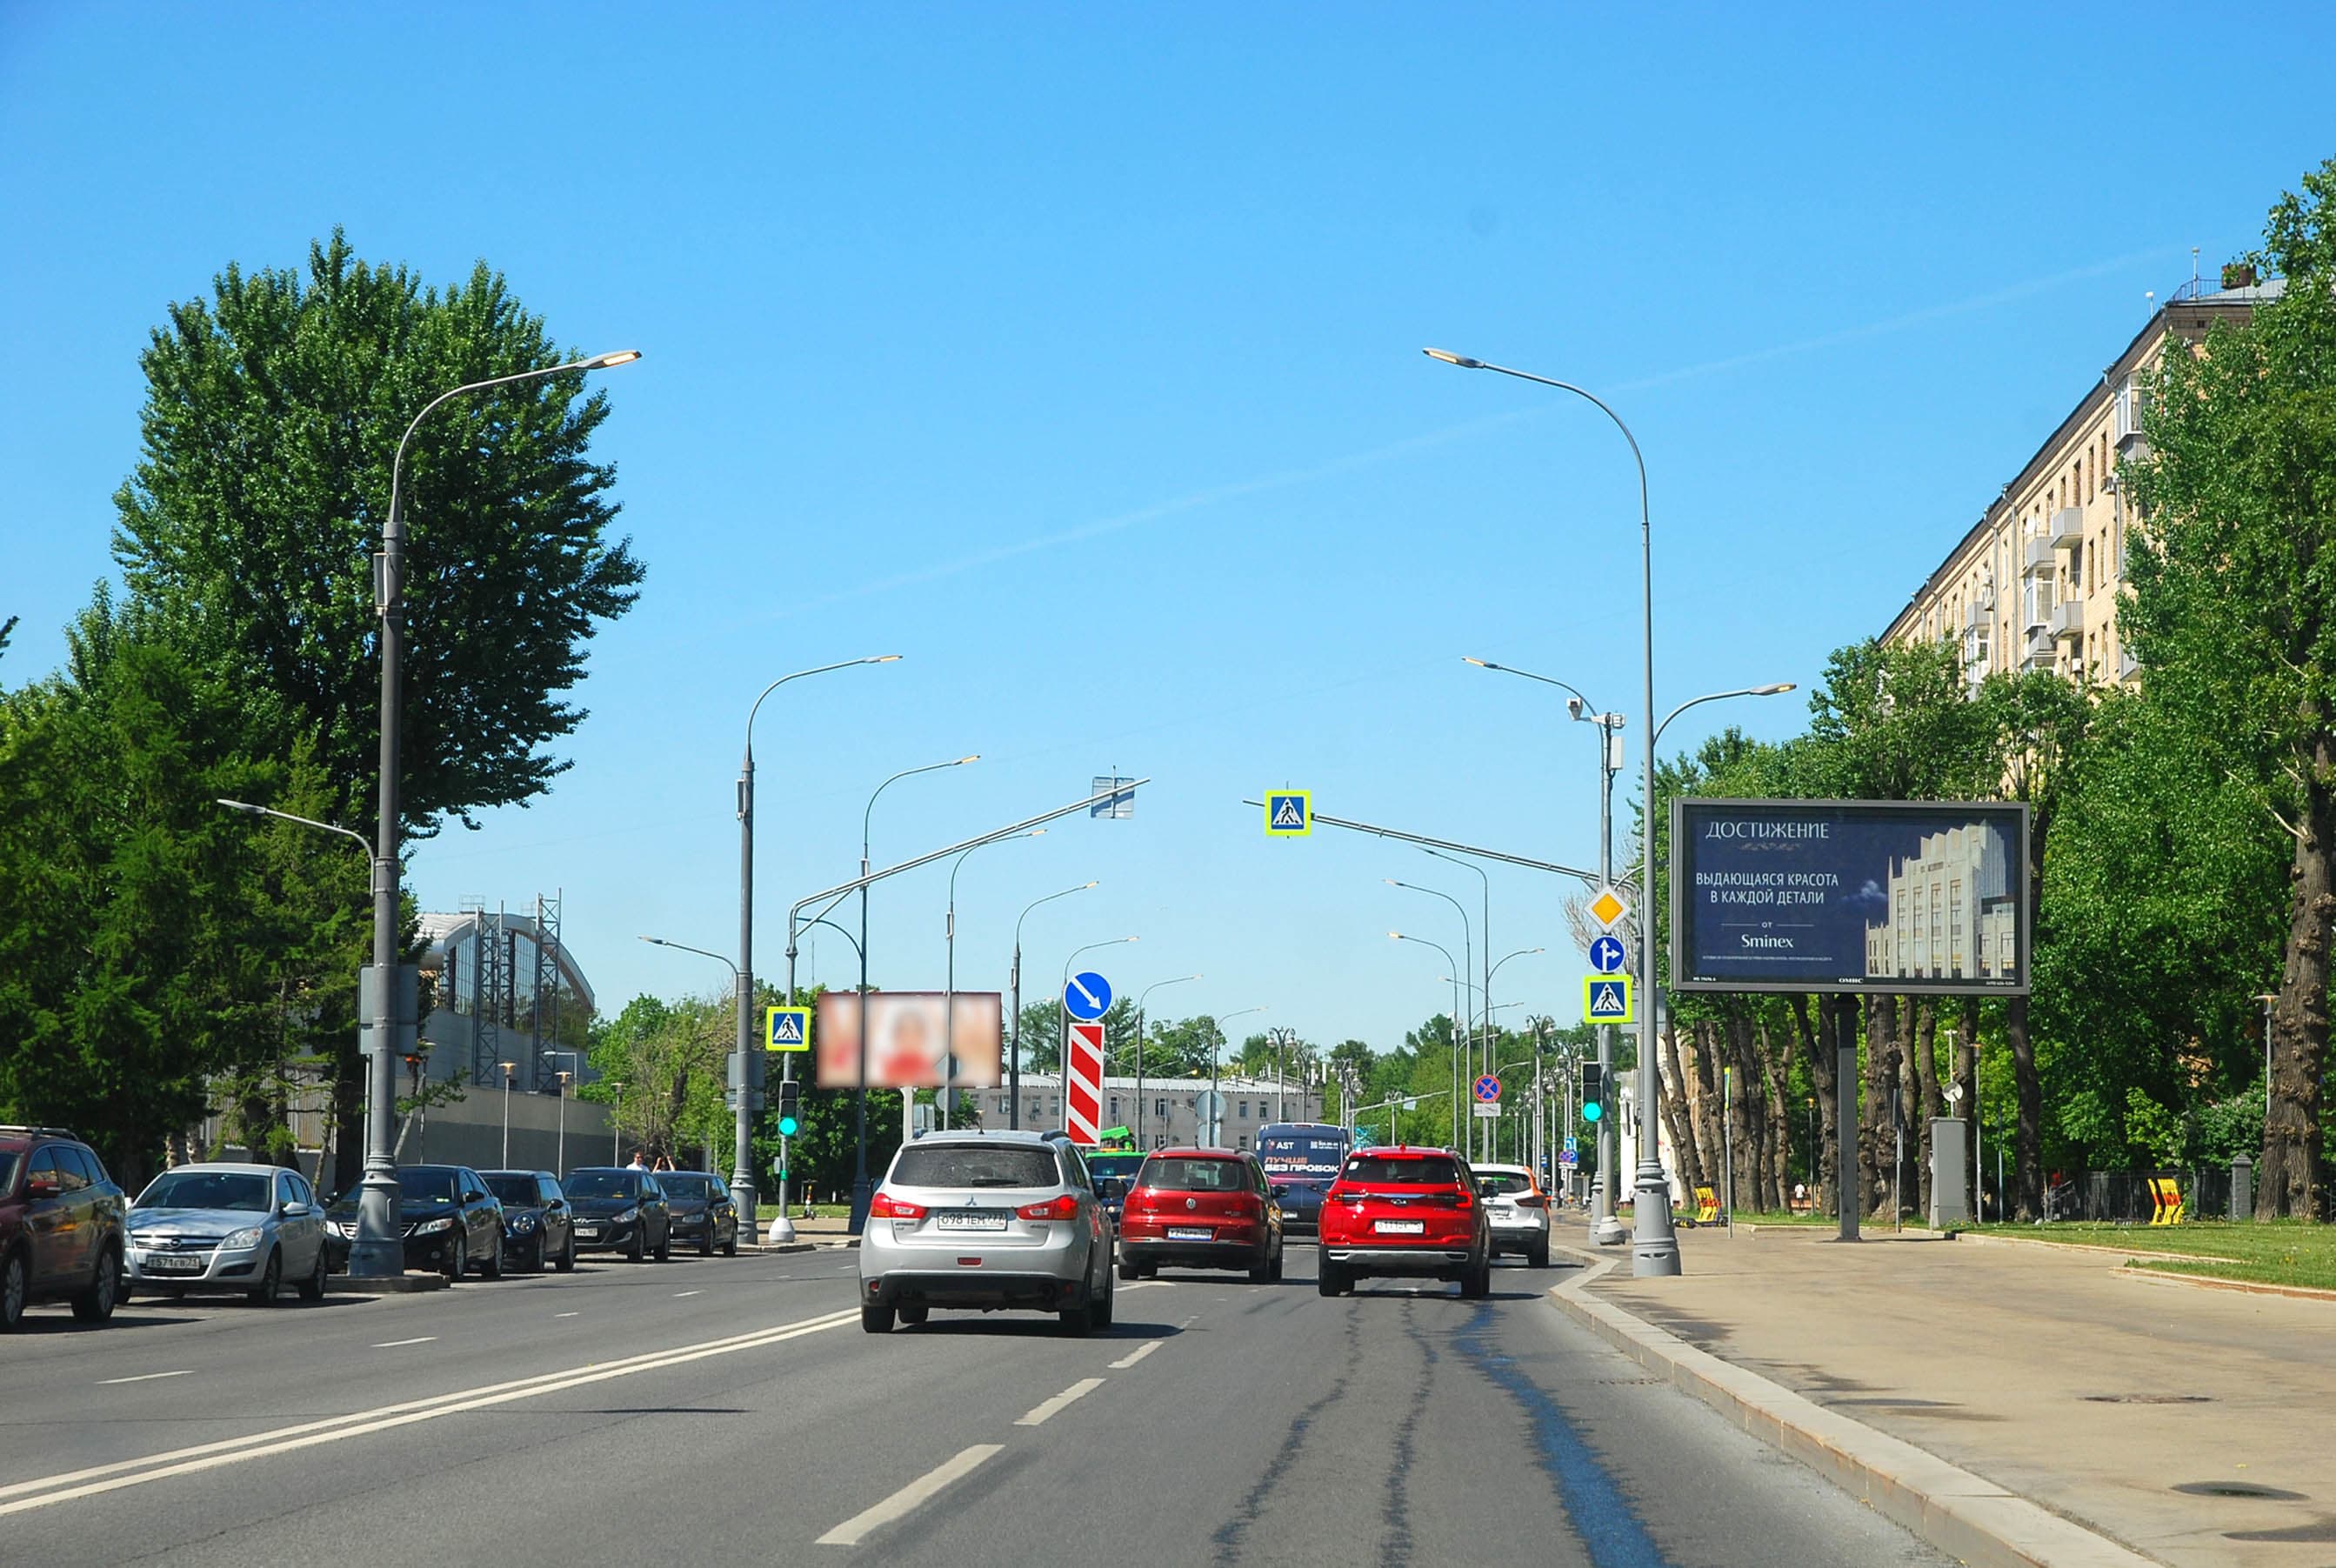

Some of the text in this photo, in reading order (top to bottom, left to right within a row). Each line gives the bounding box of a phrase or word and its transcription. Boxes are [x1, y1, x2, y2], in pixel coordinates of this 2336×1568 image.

[1705, 821, 1830, 840] ДОСТИЖЕНИЕ
[1696, 872, 1839, 887] ВЫДАЮЩАЯСЯ КРАСОТА
[1711, 889, 1825, 906] В КАЖДОЙ ДЕТАЛИ
[1741, 934, 1794, 949] Sminex
